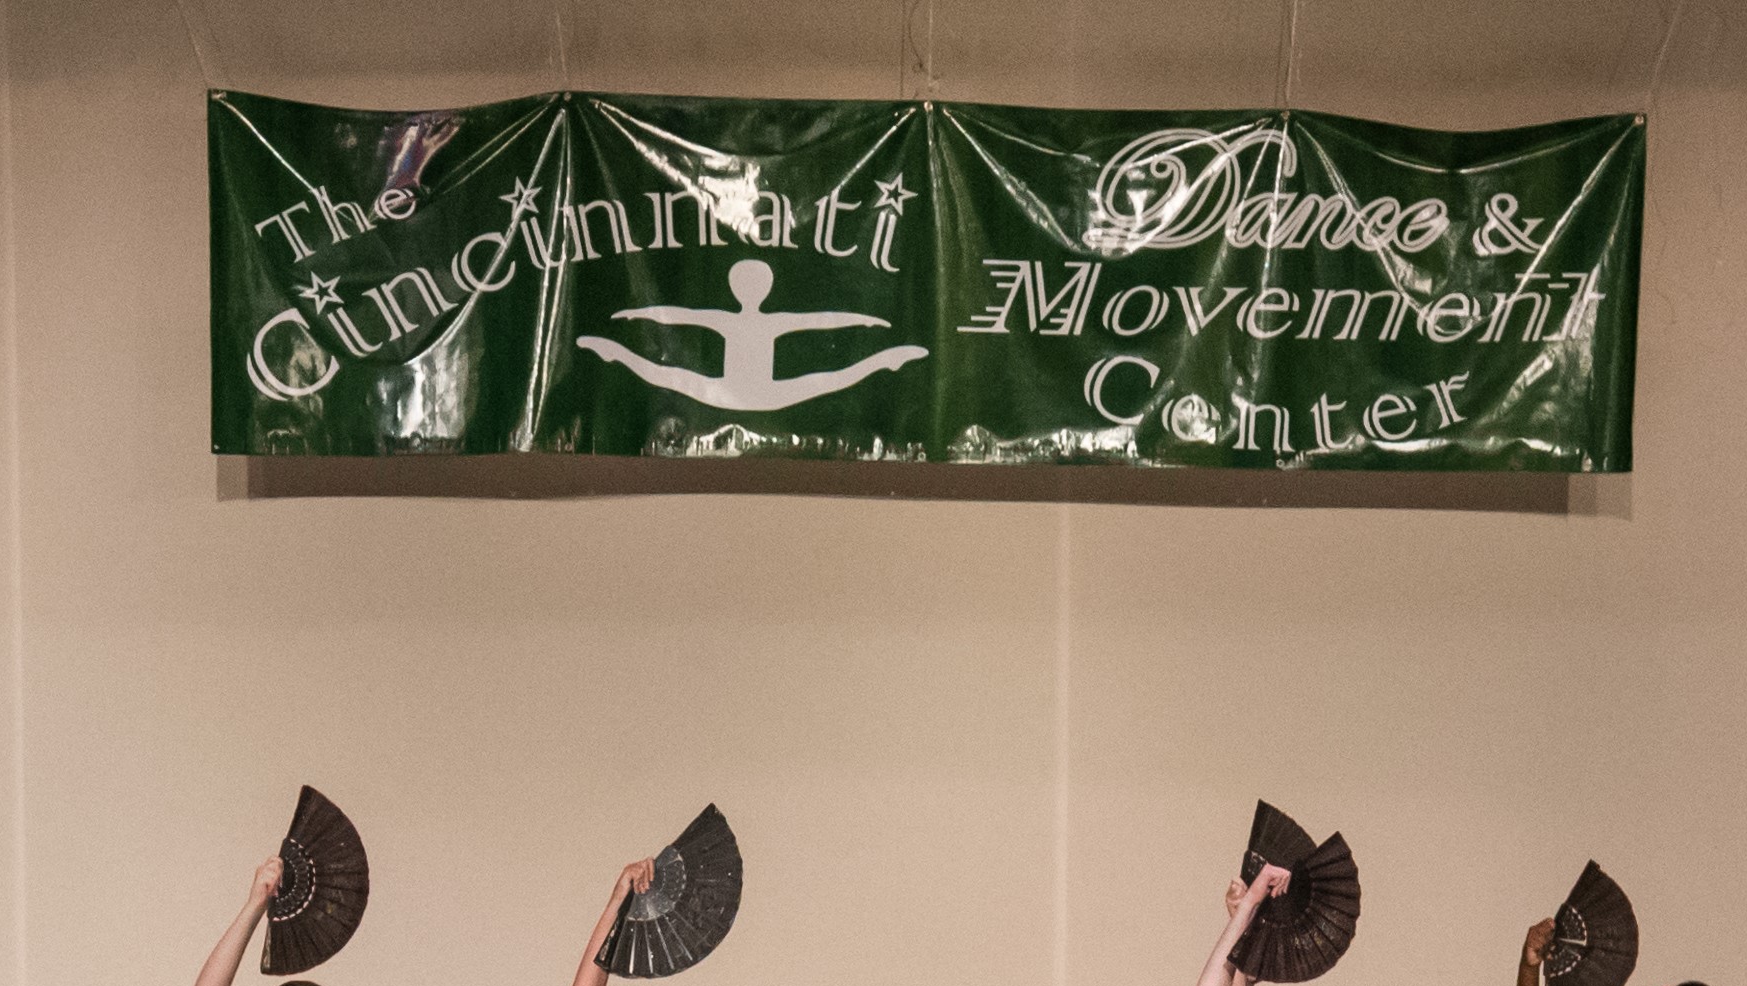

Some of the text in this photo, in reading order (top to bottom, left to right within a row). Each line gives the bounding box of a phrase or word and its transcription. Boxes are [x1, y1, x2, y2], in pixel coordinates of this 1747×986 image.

[254, 183, 418, 263] The
[1082, 128, 1546, 257] Dance &
[247, 172, 919, 401] Cincinnati
[956, 259, 1607, 344] Movement
[1083, 355, 1470, 452] Center
